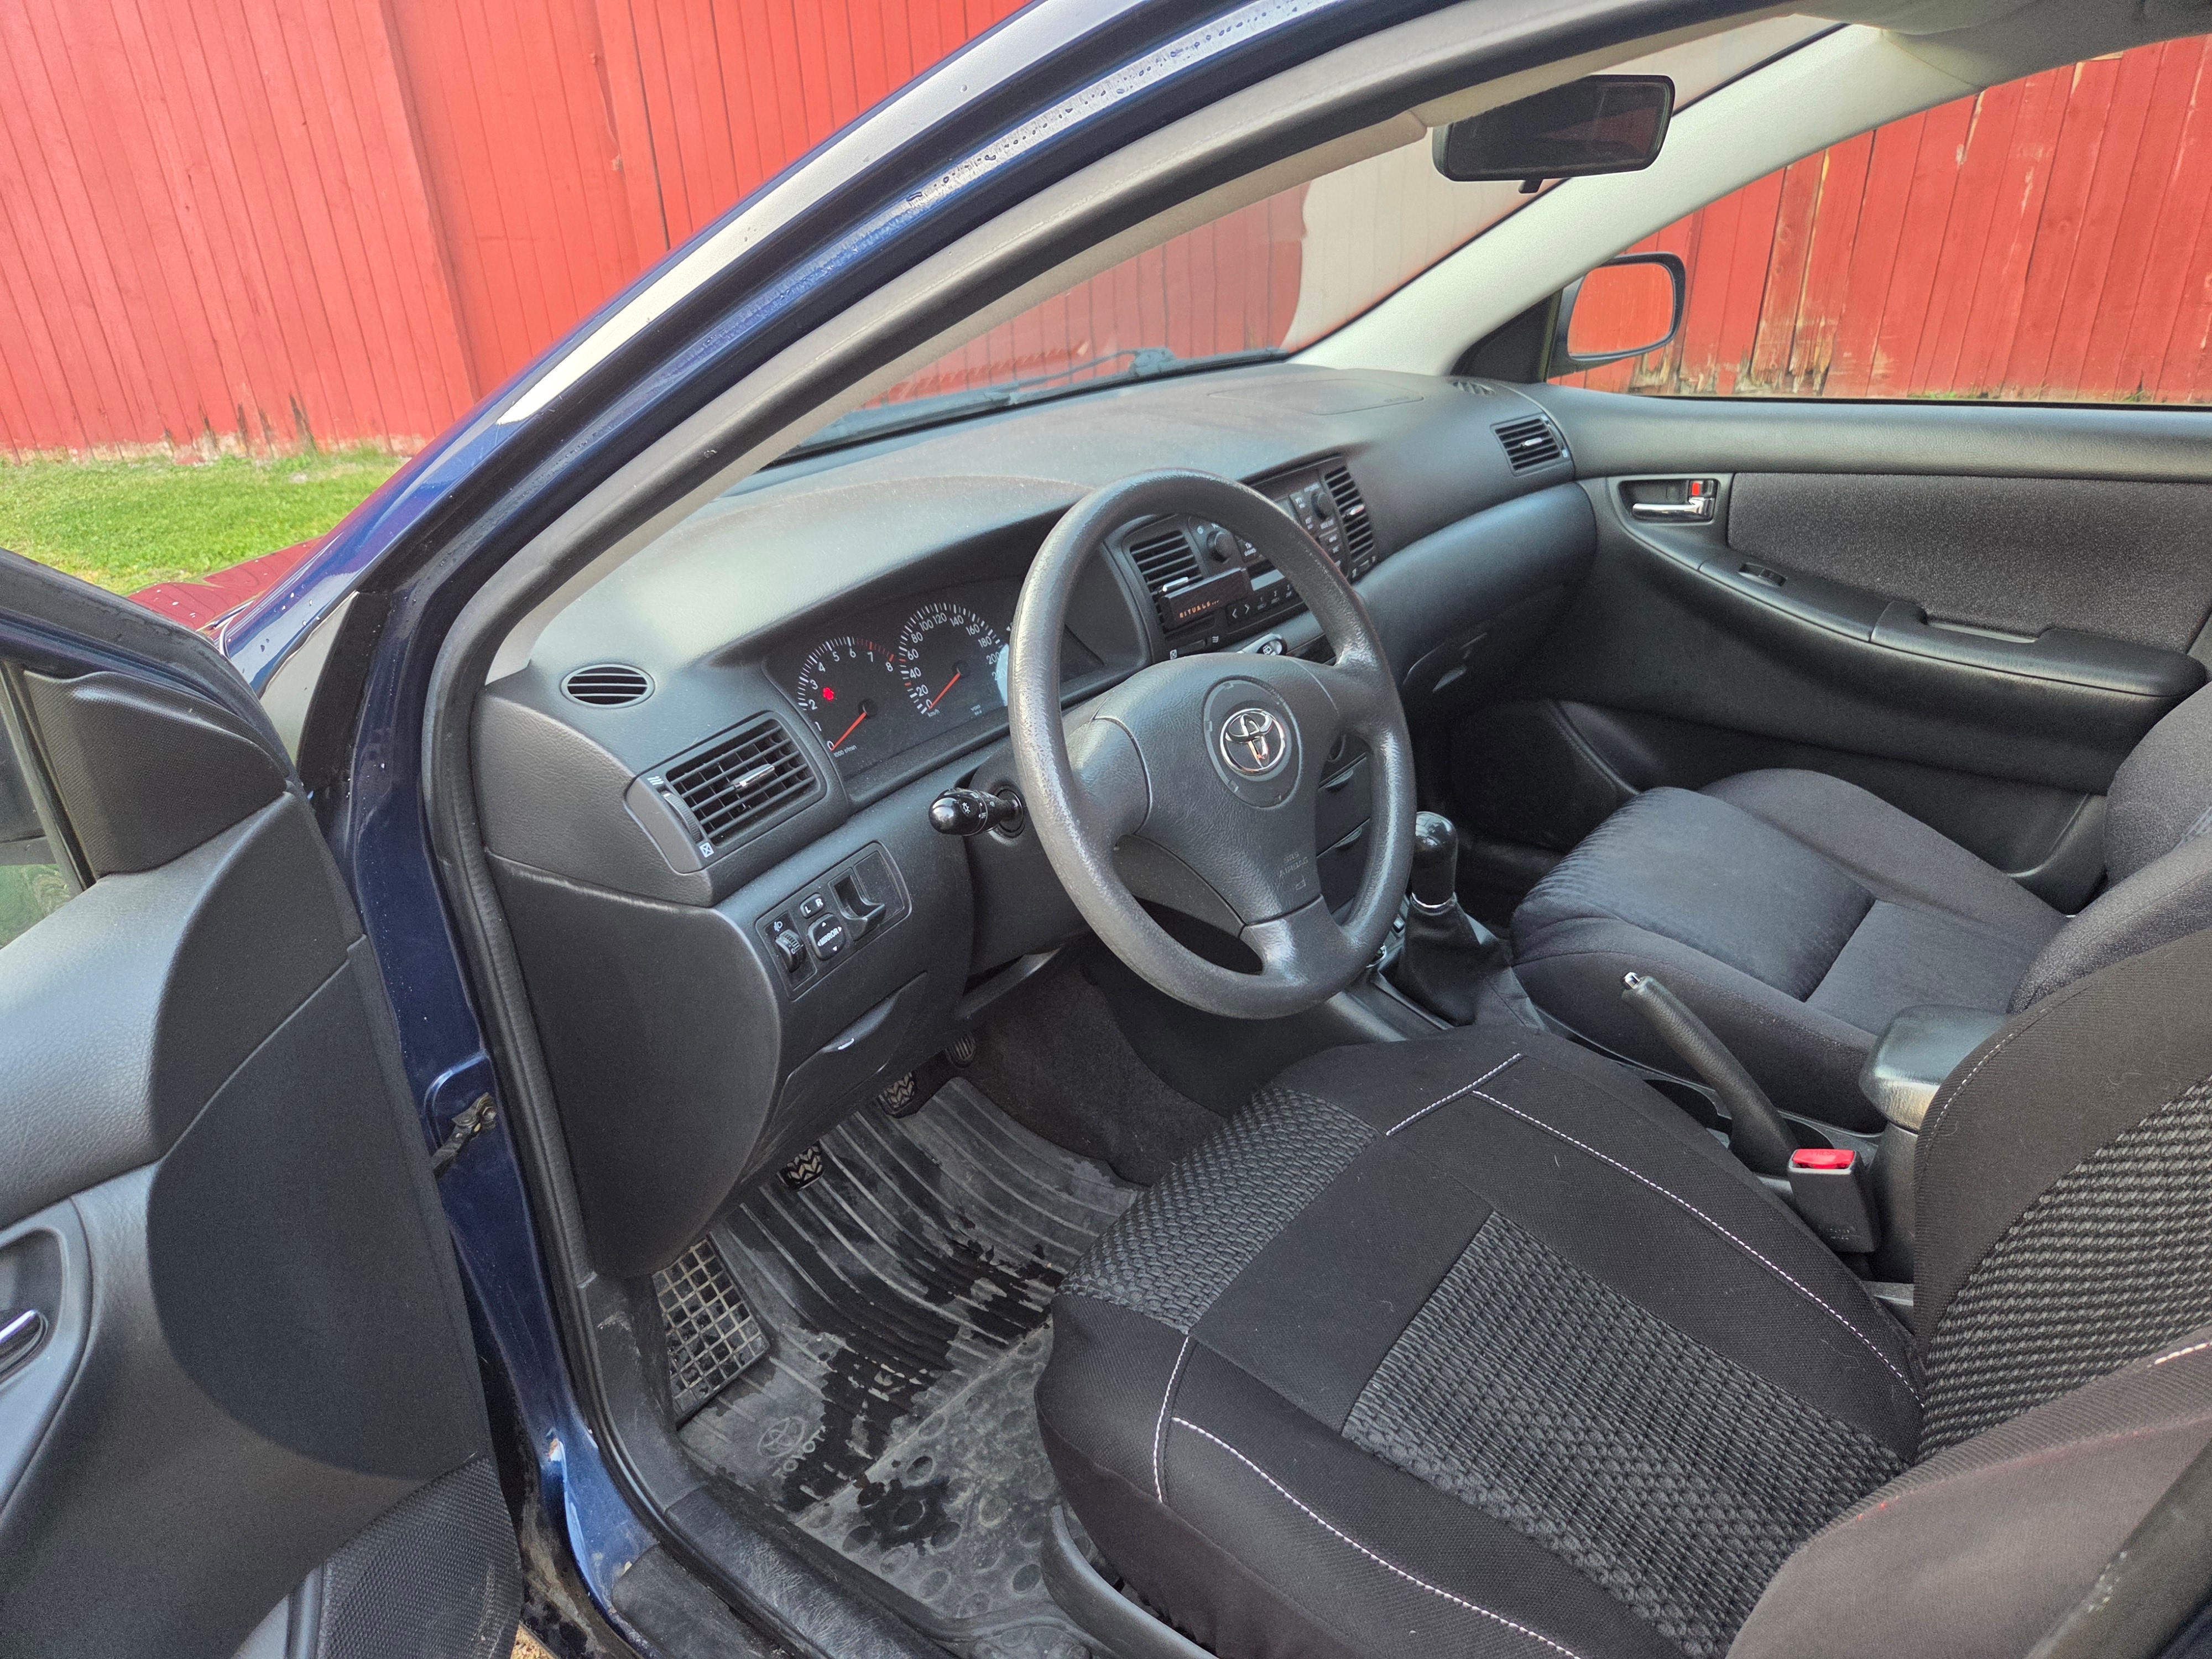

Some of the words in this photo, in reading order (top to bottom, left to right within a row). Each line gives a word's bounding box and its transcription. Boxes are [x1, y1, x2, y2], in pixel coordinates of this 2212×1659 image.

[932, 612, 947, 624] 120
[950, 614, 964, 627] 140
[919, 619, 933, 632] 100
[966, 623, 980, 636] 160
[911, 632, 924, 644] 80
[978, 636, 992, 648] 180
[832, 651, 840, 662] 5
[849, 648, 857, 658] 6
[867, 651, 873, 662] 7
[907, 648, 919, 660] 60
[986, 651, 1000, 665] 200
[818, 662, 826, 672] 4
[885, 661, 894, 672] 8
[910, 666, 922, 679] 40
[992, 668, 1006, 681] 220
[810, 679, 818, 690] 3
[916, 684, 928, 697] 20
[808, 699, 817, 710] 2
[927, 708, 940, 718] km/h
[815, 721, 822, 731] 1
[827, 740, 834, 750] 0
[833, 749, 844, 758] 1000
[805, 906, 811, 914] L
[815, 898, 823, 907] R
[819, 927, 839, 946] MIRROR
